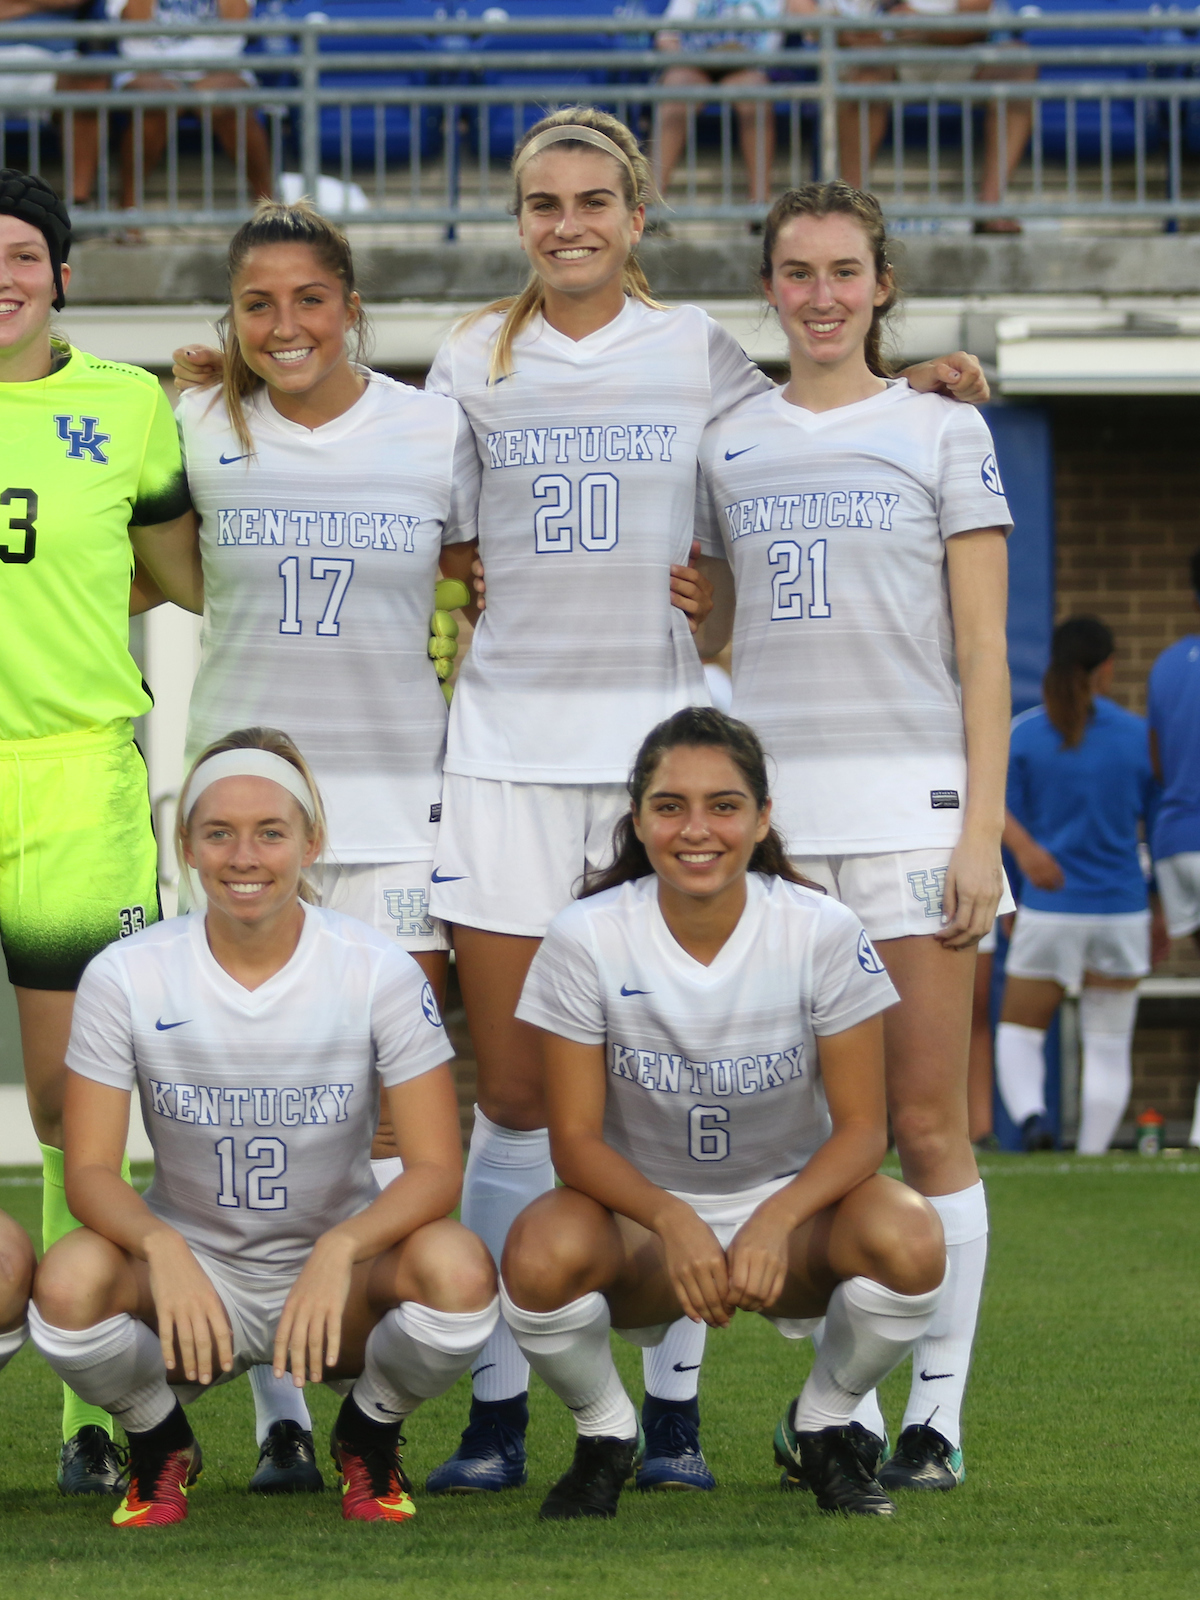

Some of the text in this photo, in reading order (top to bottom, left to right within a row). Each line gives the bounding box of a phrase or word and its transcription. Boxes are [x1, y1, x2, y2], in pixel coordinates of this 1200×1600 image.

[54, 414, 110, 465] UK
[486, 424, 678, 470] KENTUCKY
[216, 508, 421, 553] KENTUCKY
[532, 472, 620, 554] 20
[724, 491, 900, 542] KENTUCKY
[278, 556, 355, 637] 17
[767, 537, 832, 621] 21
[119, 905, 146, 939] 33
[611, 1042, 805, 1098] KENTUCKY
[149, 1079, 354, 1127] KENTUCKY
[687, 1104, 731, 1163] 6
[215, 1136, 288, 1212] 12
